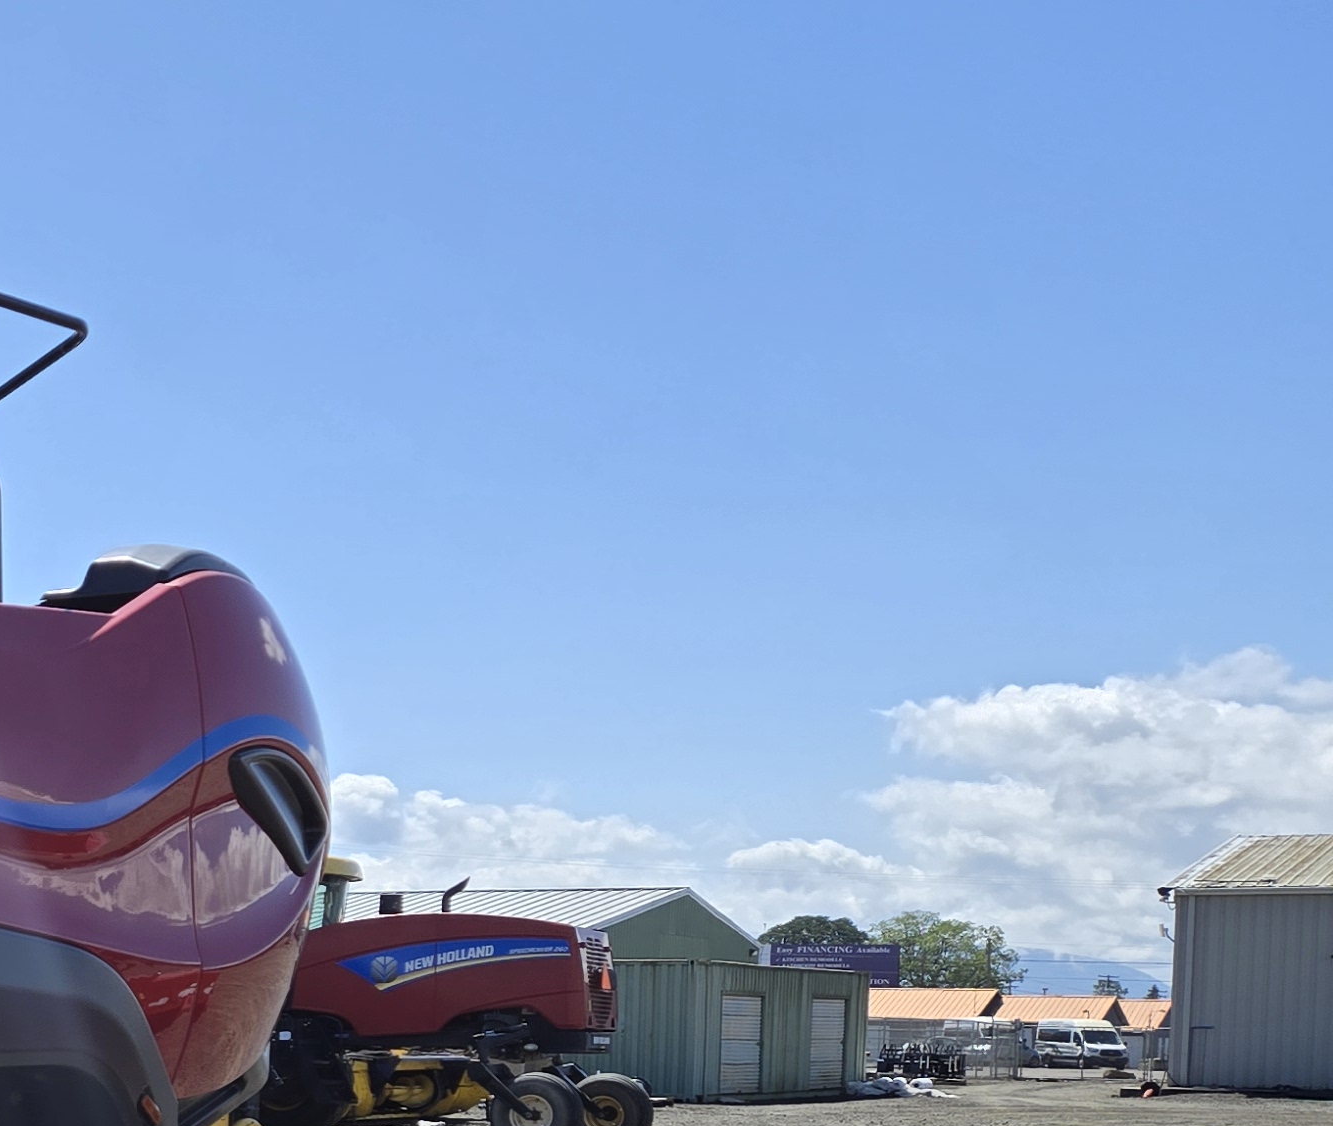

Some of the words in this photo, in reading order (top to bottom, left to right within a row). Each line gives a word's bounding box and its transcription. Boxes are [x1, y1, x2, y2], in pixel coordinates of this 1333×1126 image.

[404, 955, 434, 973] NEW
[436, 945, 494, 965] HOLLAND
[797, 946, 853, 954] FINANCING
